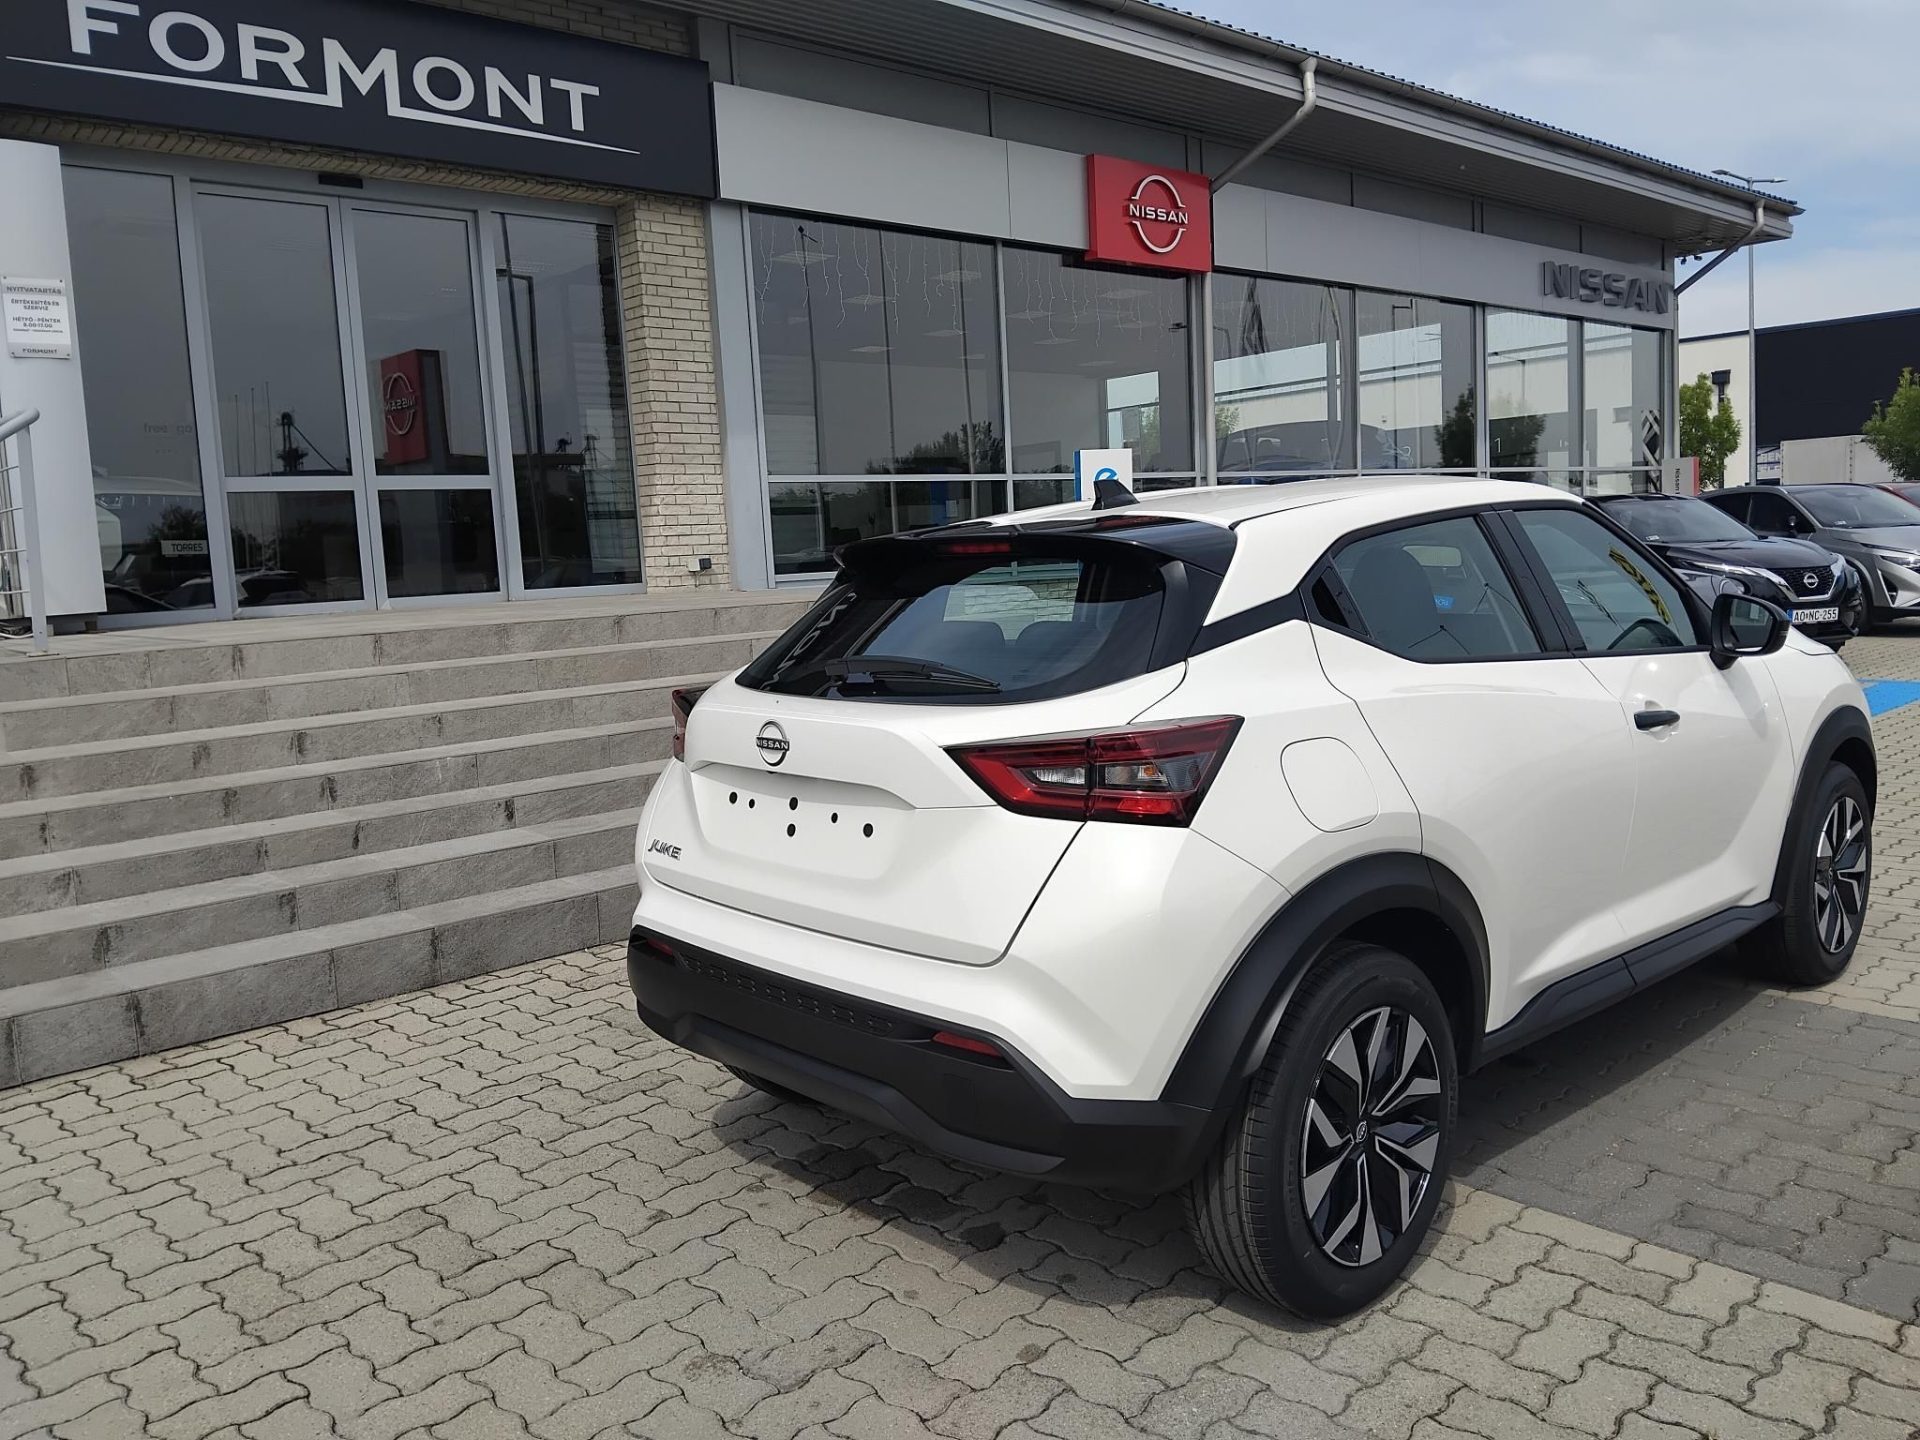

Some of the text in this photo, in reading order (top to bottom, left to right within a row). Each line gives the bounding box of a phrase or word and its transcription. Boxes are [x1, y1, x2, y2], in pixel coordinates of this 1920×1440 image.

[66, 0, 600, 132] FORMONT
[1129, 203, 1189, 225] NISSAN
[1542, 260, 1670, 314] NISSAN
[170, 543, 204, 552] TORRES
[756, 737, 790, 751] NISSAN
[648, 838, 682, 861] JUKE
